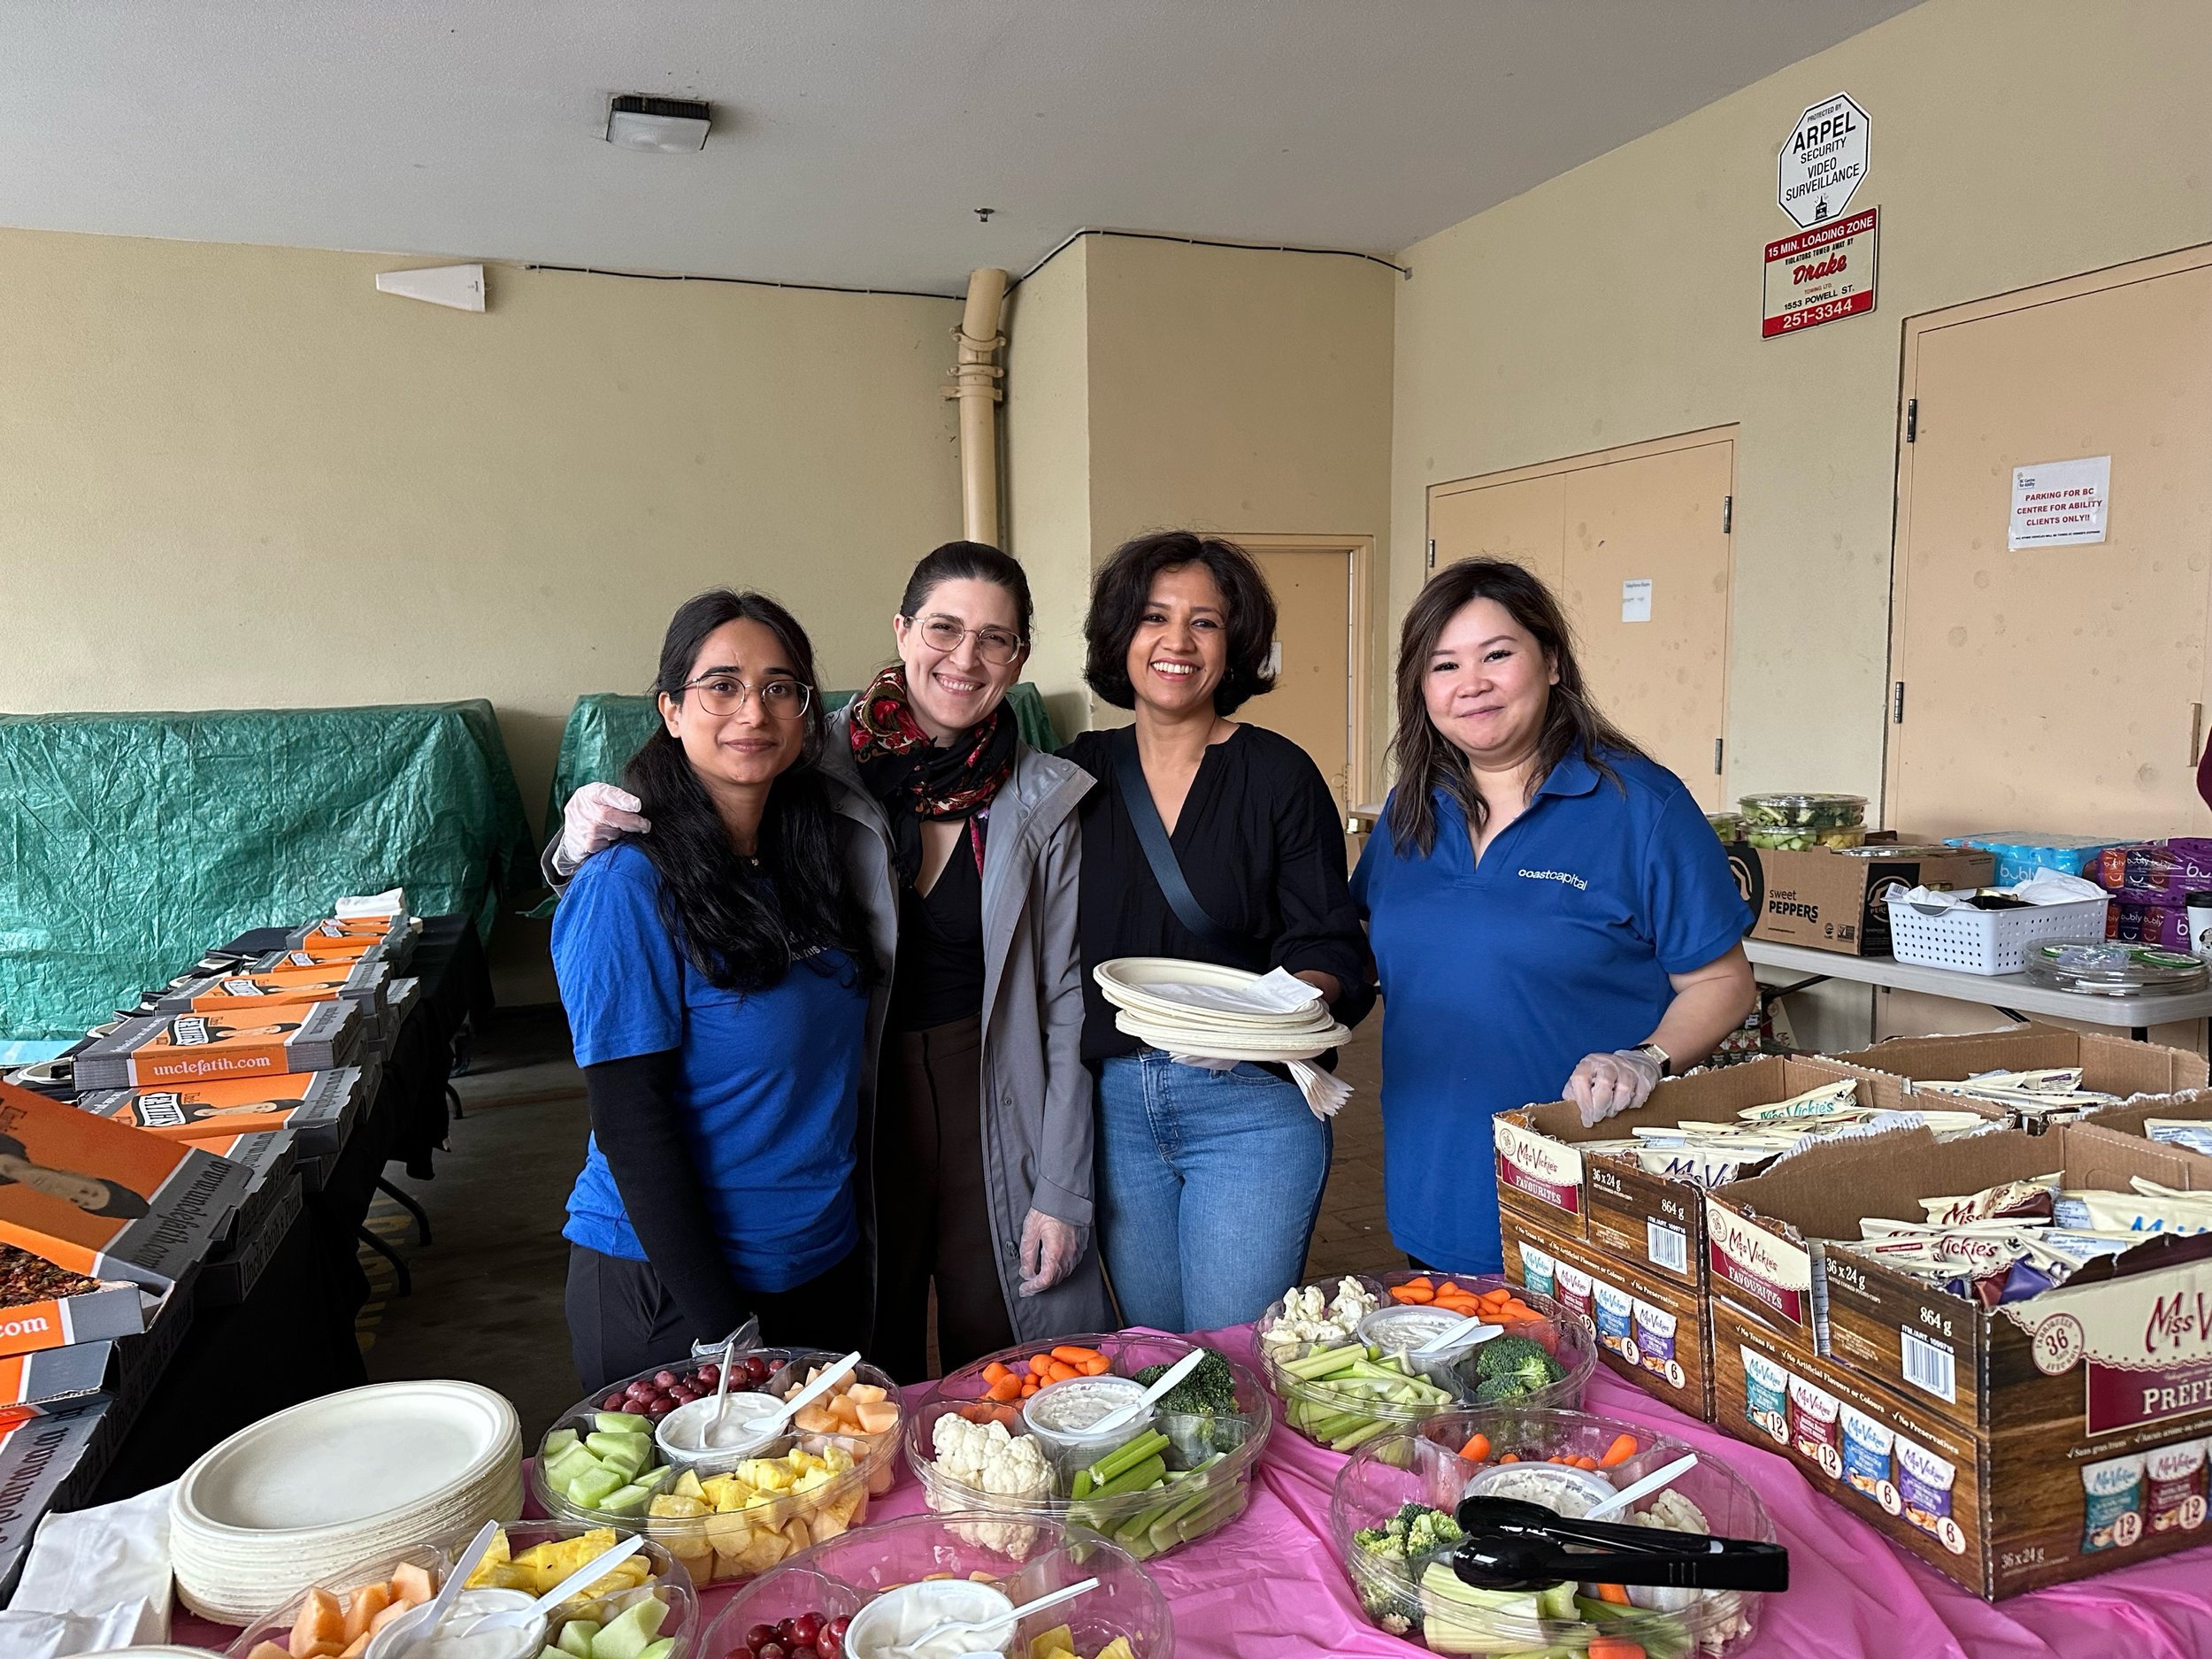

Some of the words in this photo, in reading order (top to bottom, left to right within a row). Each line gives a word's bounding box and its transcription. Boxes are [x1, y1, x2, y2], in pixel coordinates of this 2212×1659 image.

[1807, 105, 1834, 123] PROTECTED
[1835, 103, 1842, 111] BY
[1793, 111, 1856, 154] ARPEL
[1801, 136, 1847, 165] SECURITY
[1808, 157, 1837, 179] VIDEO
[1786, 163, 1860, 202] SURVEILLANCE
[1768, 246, 1778, 257] 15
[1780, 240, 1800, 255] MIN.
[1801, 226, 1845, 248] LOADING
[1846, 215, 1873, 234] ZONE
[1785, 251, 1811, 265] VIOLATORS
[1812, 245, 1830, 257] TOWED
[1832, 240, 1845, 251] AWAY
[1847, 237, 1854, 246] BY
[1793, 252, 1847, 286] Drake
[1784, 299, 1802, 311] 1553
[1805, 289, 1838, 305] POWELL
[1841, 284, 1855, 296] ST.
[1804, 286, 1822, 296] TOWING
[1782, 297, 1853, 329] 251-3344
[2016, 505, 2048, 515] CENTRE
[2050, 503, 2066, 511] FOR
[2068, 500, 2102, 510] ABILITY
[2025, 491, 2062, 502] PARKING
[2063, 488, 2080, 498] FOR
[2026, 517, 2060, 526] CLIENTS
[2062, 514, 2090, 524] ONLY!!
[1517, 869, 1587, 891] coastcapital
[1770, 889, 1797, 901] sweet
[1769, 900, 1818, 923] PEPPERS
[153, 1056, 271, 1076] unclefatih.com
[1786, 1099, 1835, 1118] Vickie's
[1517, 1141, 1532, 1166] Miss
[1532, 1148, 1558, 1175] Vickie's
[1516, 1176, 1562, 1204] FAVOURITES
[1593, 1168, 1601, 1182] 36
[1601, 1174, 1606, 1184] x
[1607, 1173, 1615, 1187] 24
[1616, 1179, 1621, 1192] g
[1662, 1199, 1677, 1216] 864
[1678, 1206, 1685, 1221] g
[1730, 1227, 1747, 1257] Miss
[1747, 1238, 1779, 1272] Vickie's
[1560, 1247, 1579, 1260] Artificial
[1580, 1256, 1600, 1271] Flavours
[1607, 1269, 1626, 1282] Colours
[1826, 1257, 1837, 1275] 36
[1839, 1266, 1845, 1279] x
[1846, 1265, 1857, 1284] 24
[1858, 1275, 1866, 1290] g
[1635, 1282, 1643, 1292] No
[1643, 1286, 1678, 1308] Preservatives
[1728, 1265, 1783, 1310] FAVOURITES
[1920, 1306, 1941, 1329] 864
[1943, 1320, 1952, 1337] g
[2145, 1292, 2195, 1354] Miss
[1626, 1340, 1633, 1357] 6
[1740, 1327, 1749, 1337] No
[1749, 1332, 1765, 1346] Trans
[1765, 1340, 1776, 1352] Fat
[2046, 1327, 2069, 1356] 36
[1671, 1363, 1678, 1380] 6
[1786, 1353, 1796, 1363] No
[1797, 1357, 1823, 1378] Artificial
[1824, 1373, 1850, 1394] Flavours
[1851, 1389, 1859, 1398] or
[1859, 1391, 1885, 1413] Colours
[1770, 1413, 1784, 1436] 12
[1899, 1416, 1909, 1427] No
[1910, 1419, 1960, 1455] Preservatives
[1823, 1446, 1837, 1471] 12
[1884, 1484, 1892, 1504] 6
[2185, 1499, 2201, 1521] 12
[1946, 1522, 1955, 1542] 6
[2119, 1514, 2136, 1539] 12
